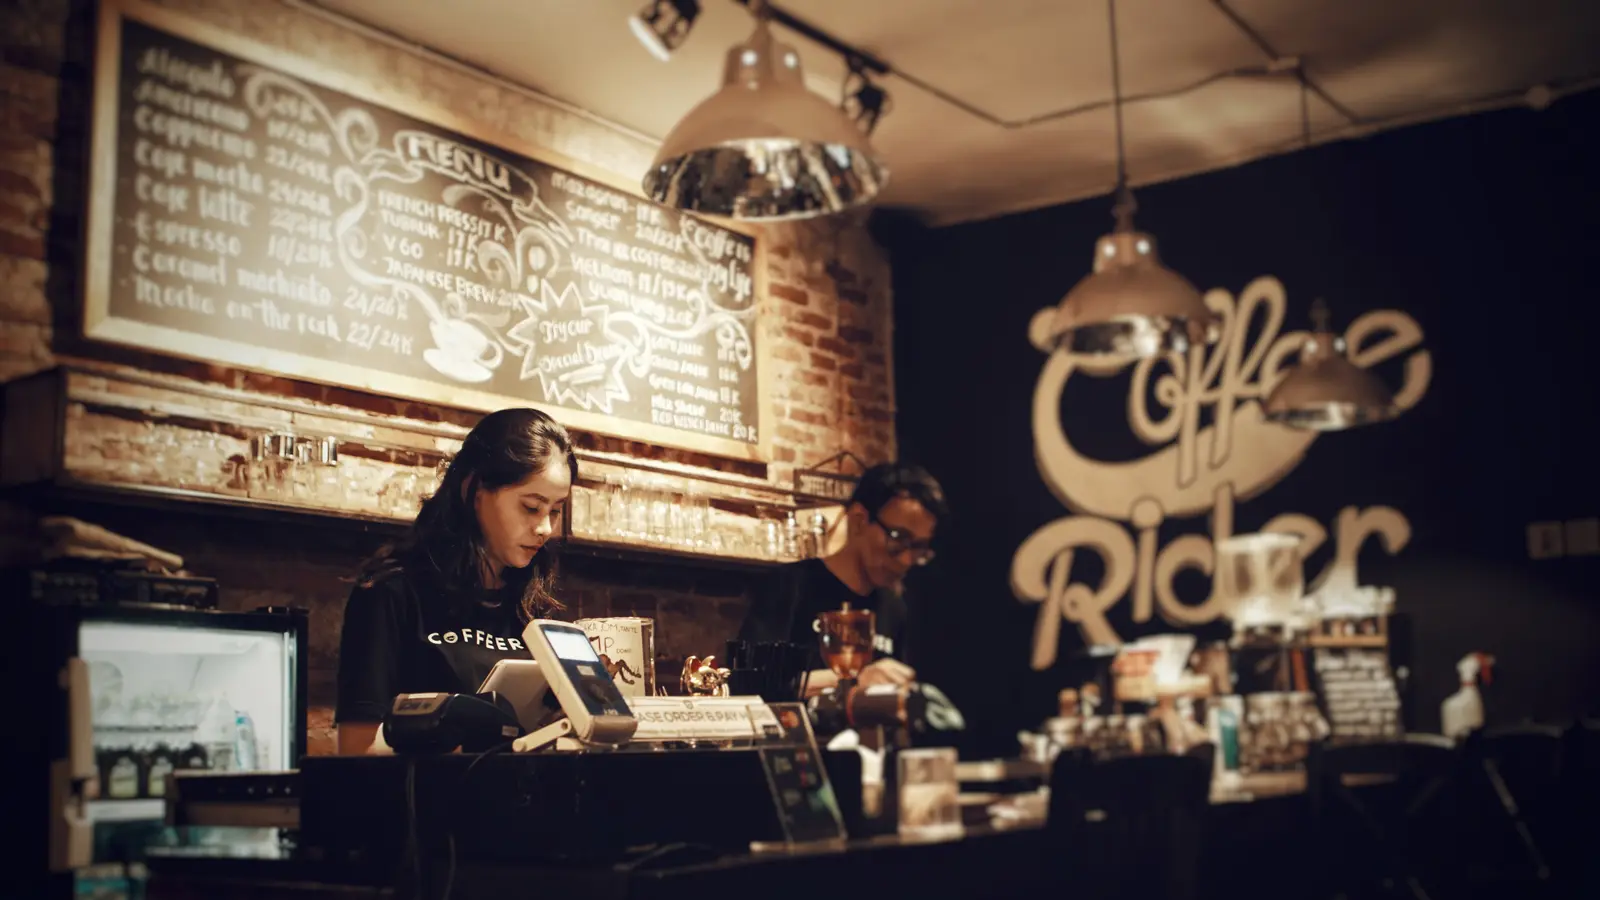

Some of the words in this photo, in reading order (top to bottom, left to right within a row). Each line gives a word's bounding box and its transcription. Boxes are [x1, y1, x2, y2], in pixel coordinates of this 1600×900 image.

[407, 136, 512, 192] MENU
[378, 190, 435, 221] FRENCH
[387, 257, 454, 292] JAPANESE
[664, 710, 706, 722] ORDER
[716, 711, 738, 722] PAY
